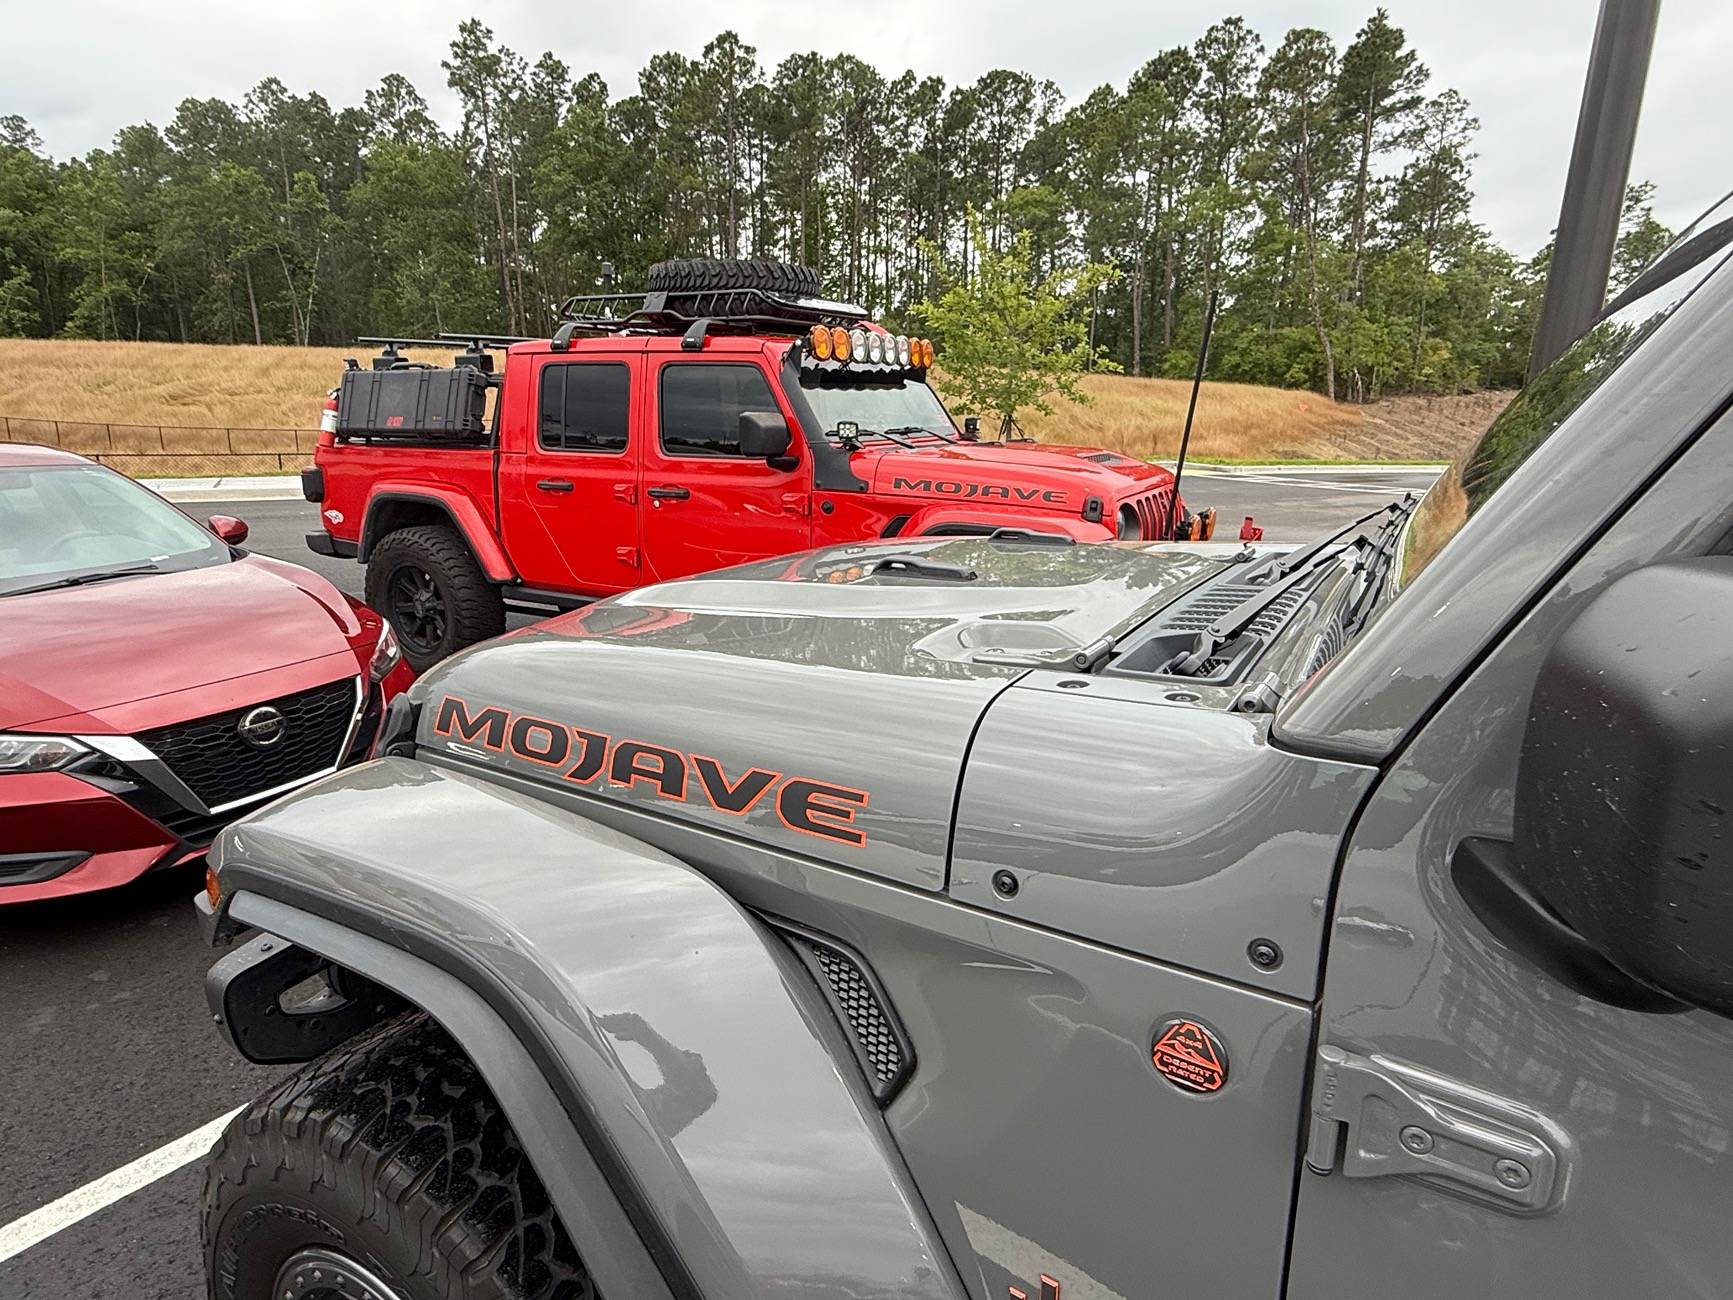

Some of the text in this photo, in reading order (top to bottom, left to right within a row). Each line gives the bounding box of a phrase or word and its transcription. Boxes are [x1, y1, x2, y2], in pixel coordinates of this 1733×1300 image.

[892, 477, 1068, 505] MOJAVE
[433, 696, 869, 848] MOJAVE
[1162, 1055, 1212, 1077] DESERT
[1167, 1065, 1205, 1083] RATED
